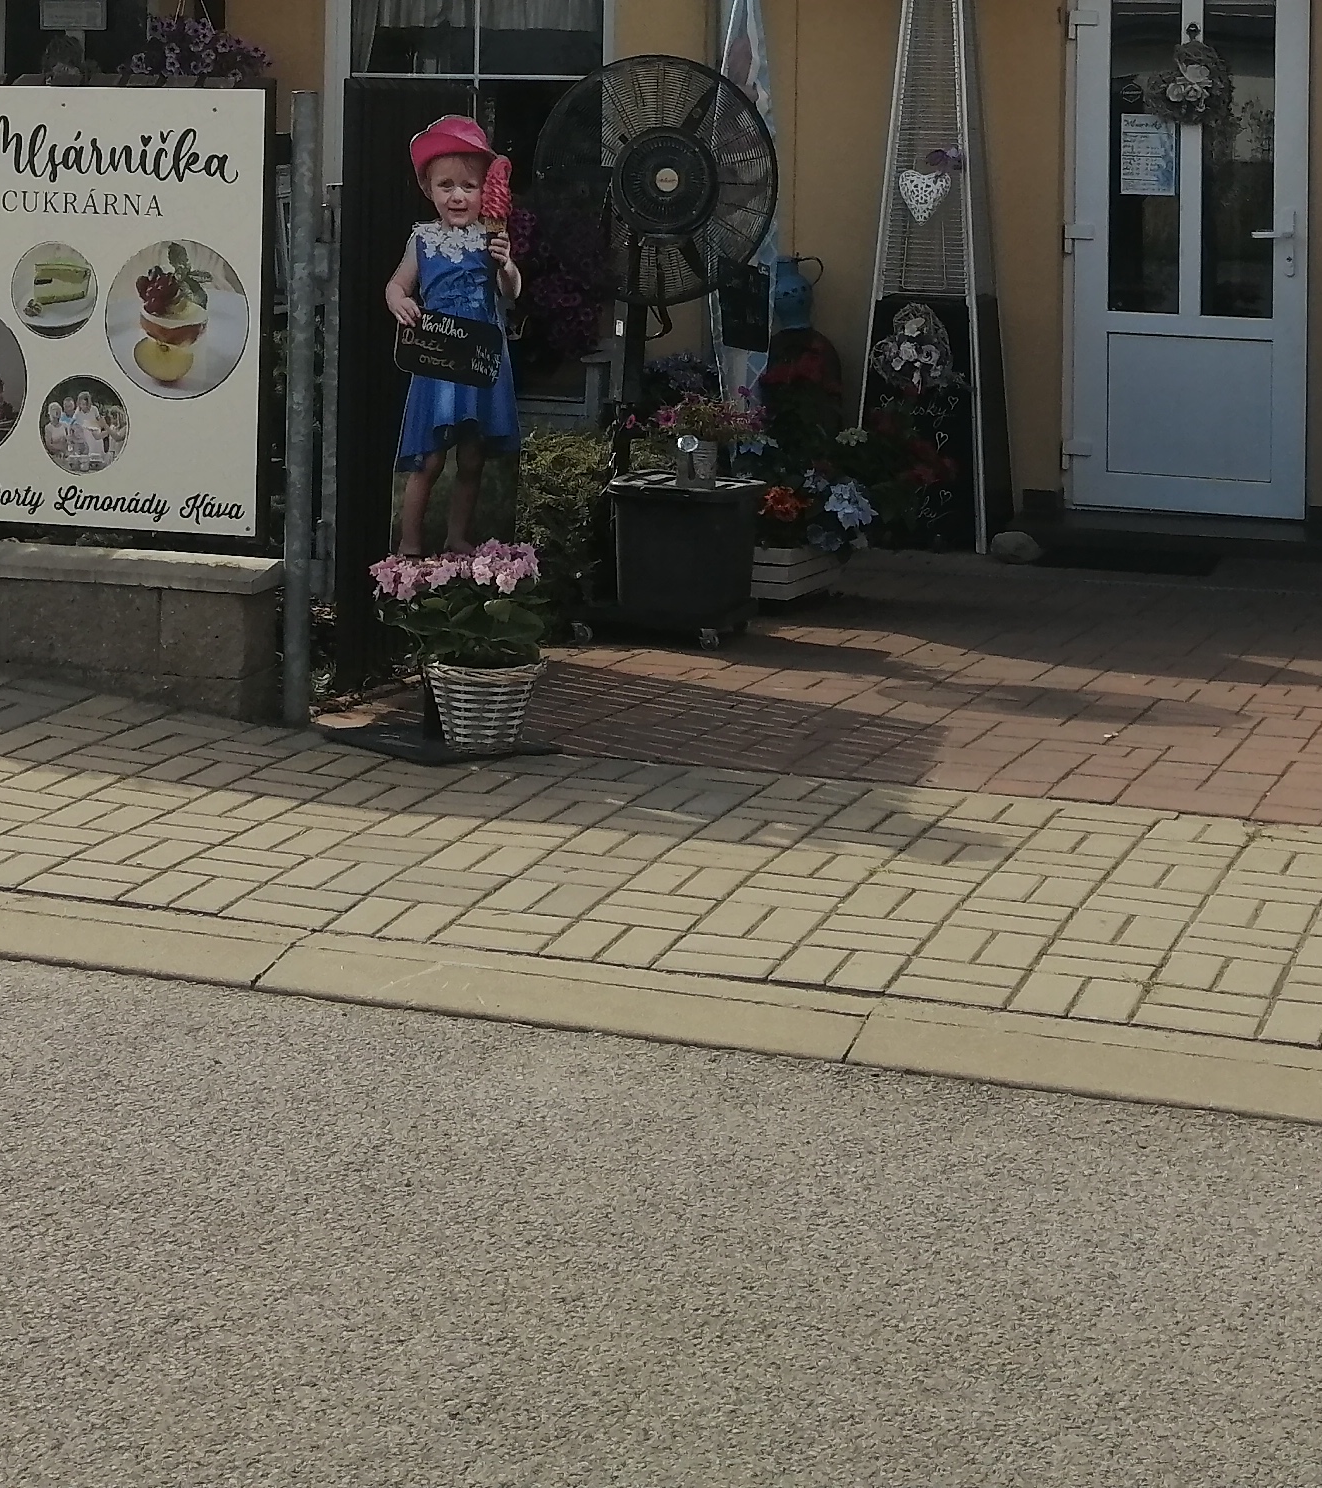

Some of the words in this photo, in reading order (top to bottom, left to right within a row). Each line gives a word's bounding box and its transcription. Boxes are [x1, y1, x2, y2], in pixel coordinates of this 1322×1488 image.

[1, 188, 164, 218] CUKRÁRNA
[53, 484, 171, 523] Limonády
[179, 491, 246, 525] Káva
